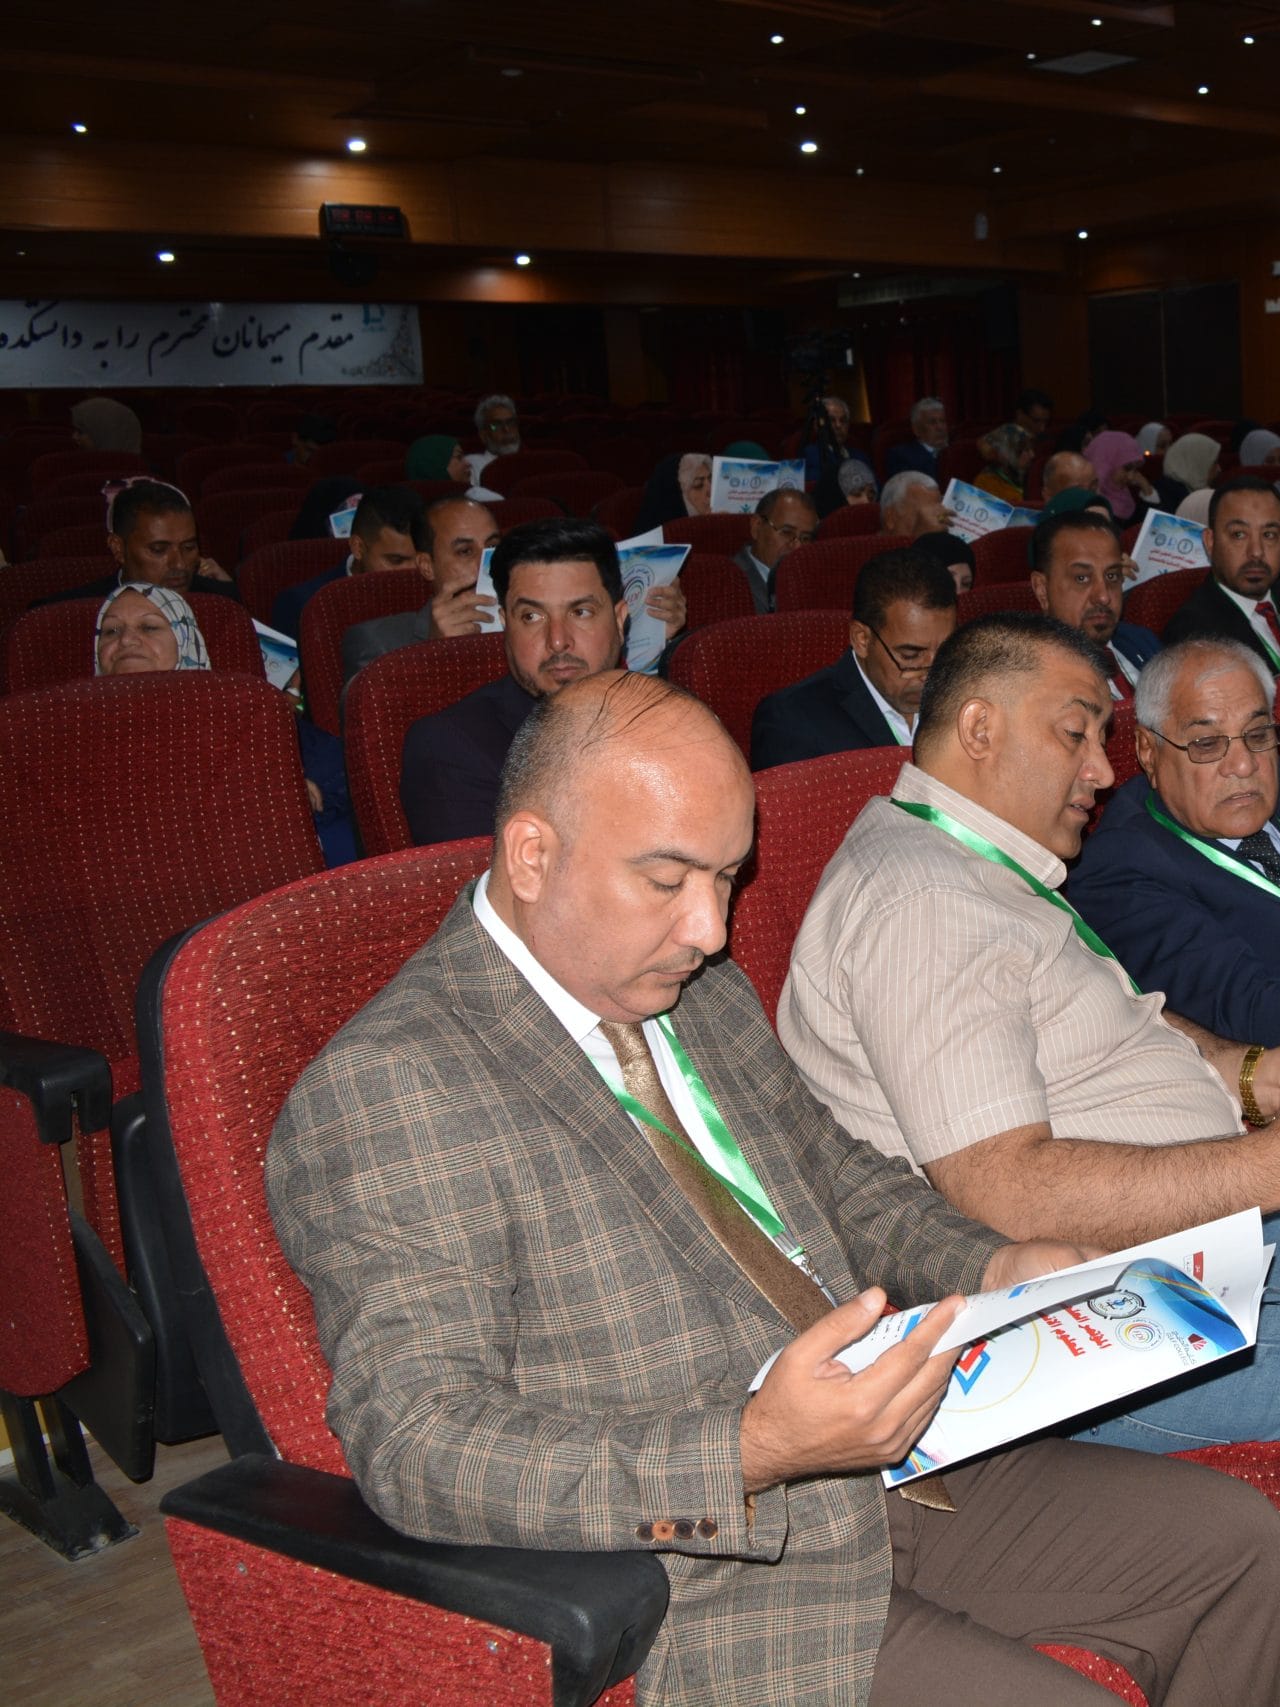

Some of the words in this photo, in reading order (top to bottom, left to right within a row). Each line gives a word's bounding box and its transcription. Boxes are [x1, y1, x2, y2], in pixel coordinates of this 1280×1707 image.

[117, 325, 140, 349] را
[147, 308, 209, 378] محترم
[211, 315, 291, 364] میهمانان
[298, 312, 354, 376] مقدم
[92, 338, 109, 369] به
[1060, 1301, 1090, 1323] العلم
[1050, 1328, 1086, 1357] للعلوم
[1078, 1324, 1112, 1349] المؤتمر
